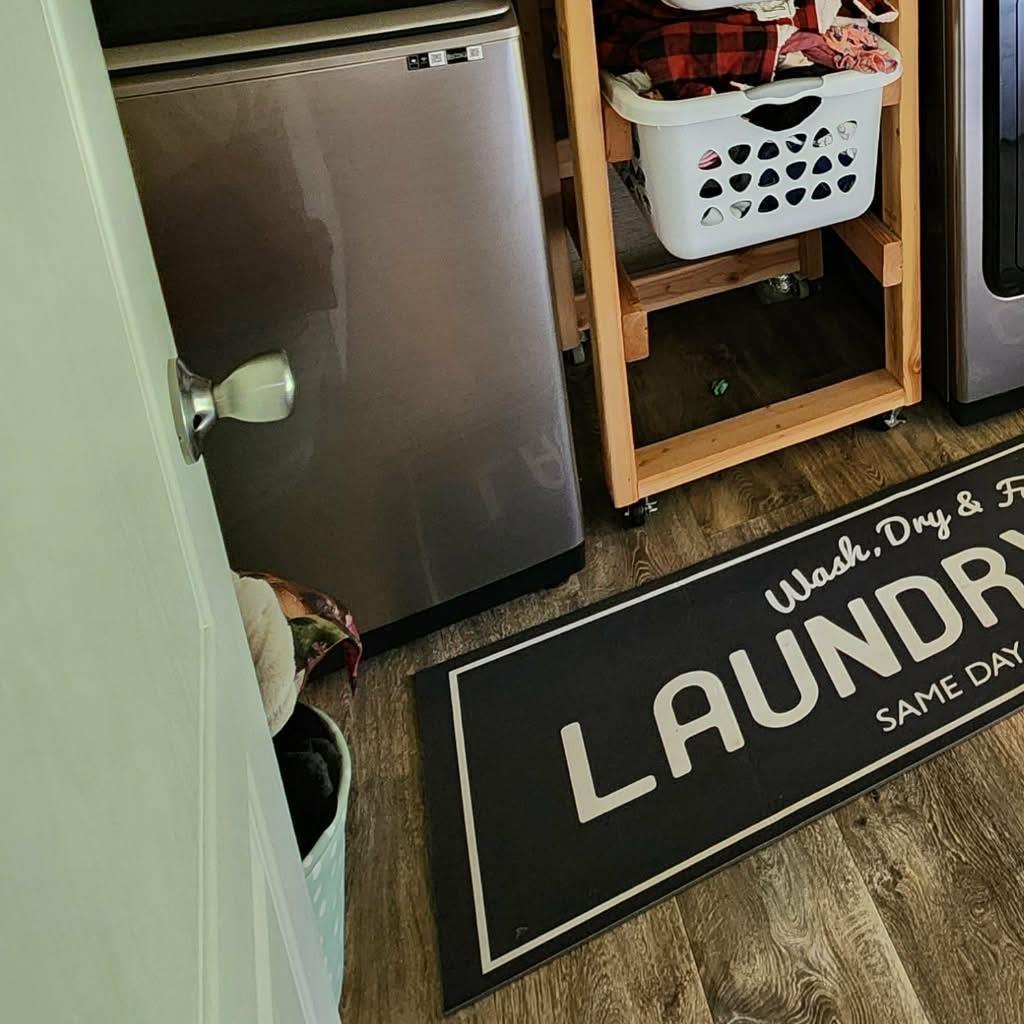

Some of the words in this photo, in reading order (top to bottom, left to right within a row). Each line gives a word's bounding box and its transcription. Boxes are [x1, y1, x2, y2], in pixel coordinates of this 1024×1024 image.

[764, 535, 881, 614] Wash,
[875, 508, 951, 547] Dry
[956, 491, 984, 517] &
[875, 674, 964, 732] SAME
[964, 641, 1023, 688] DAY
